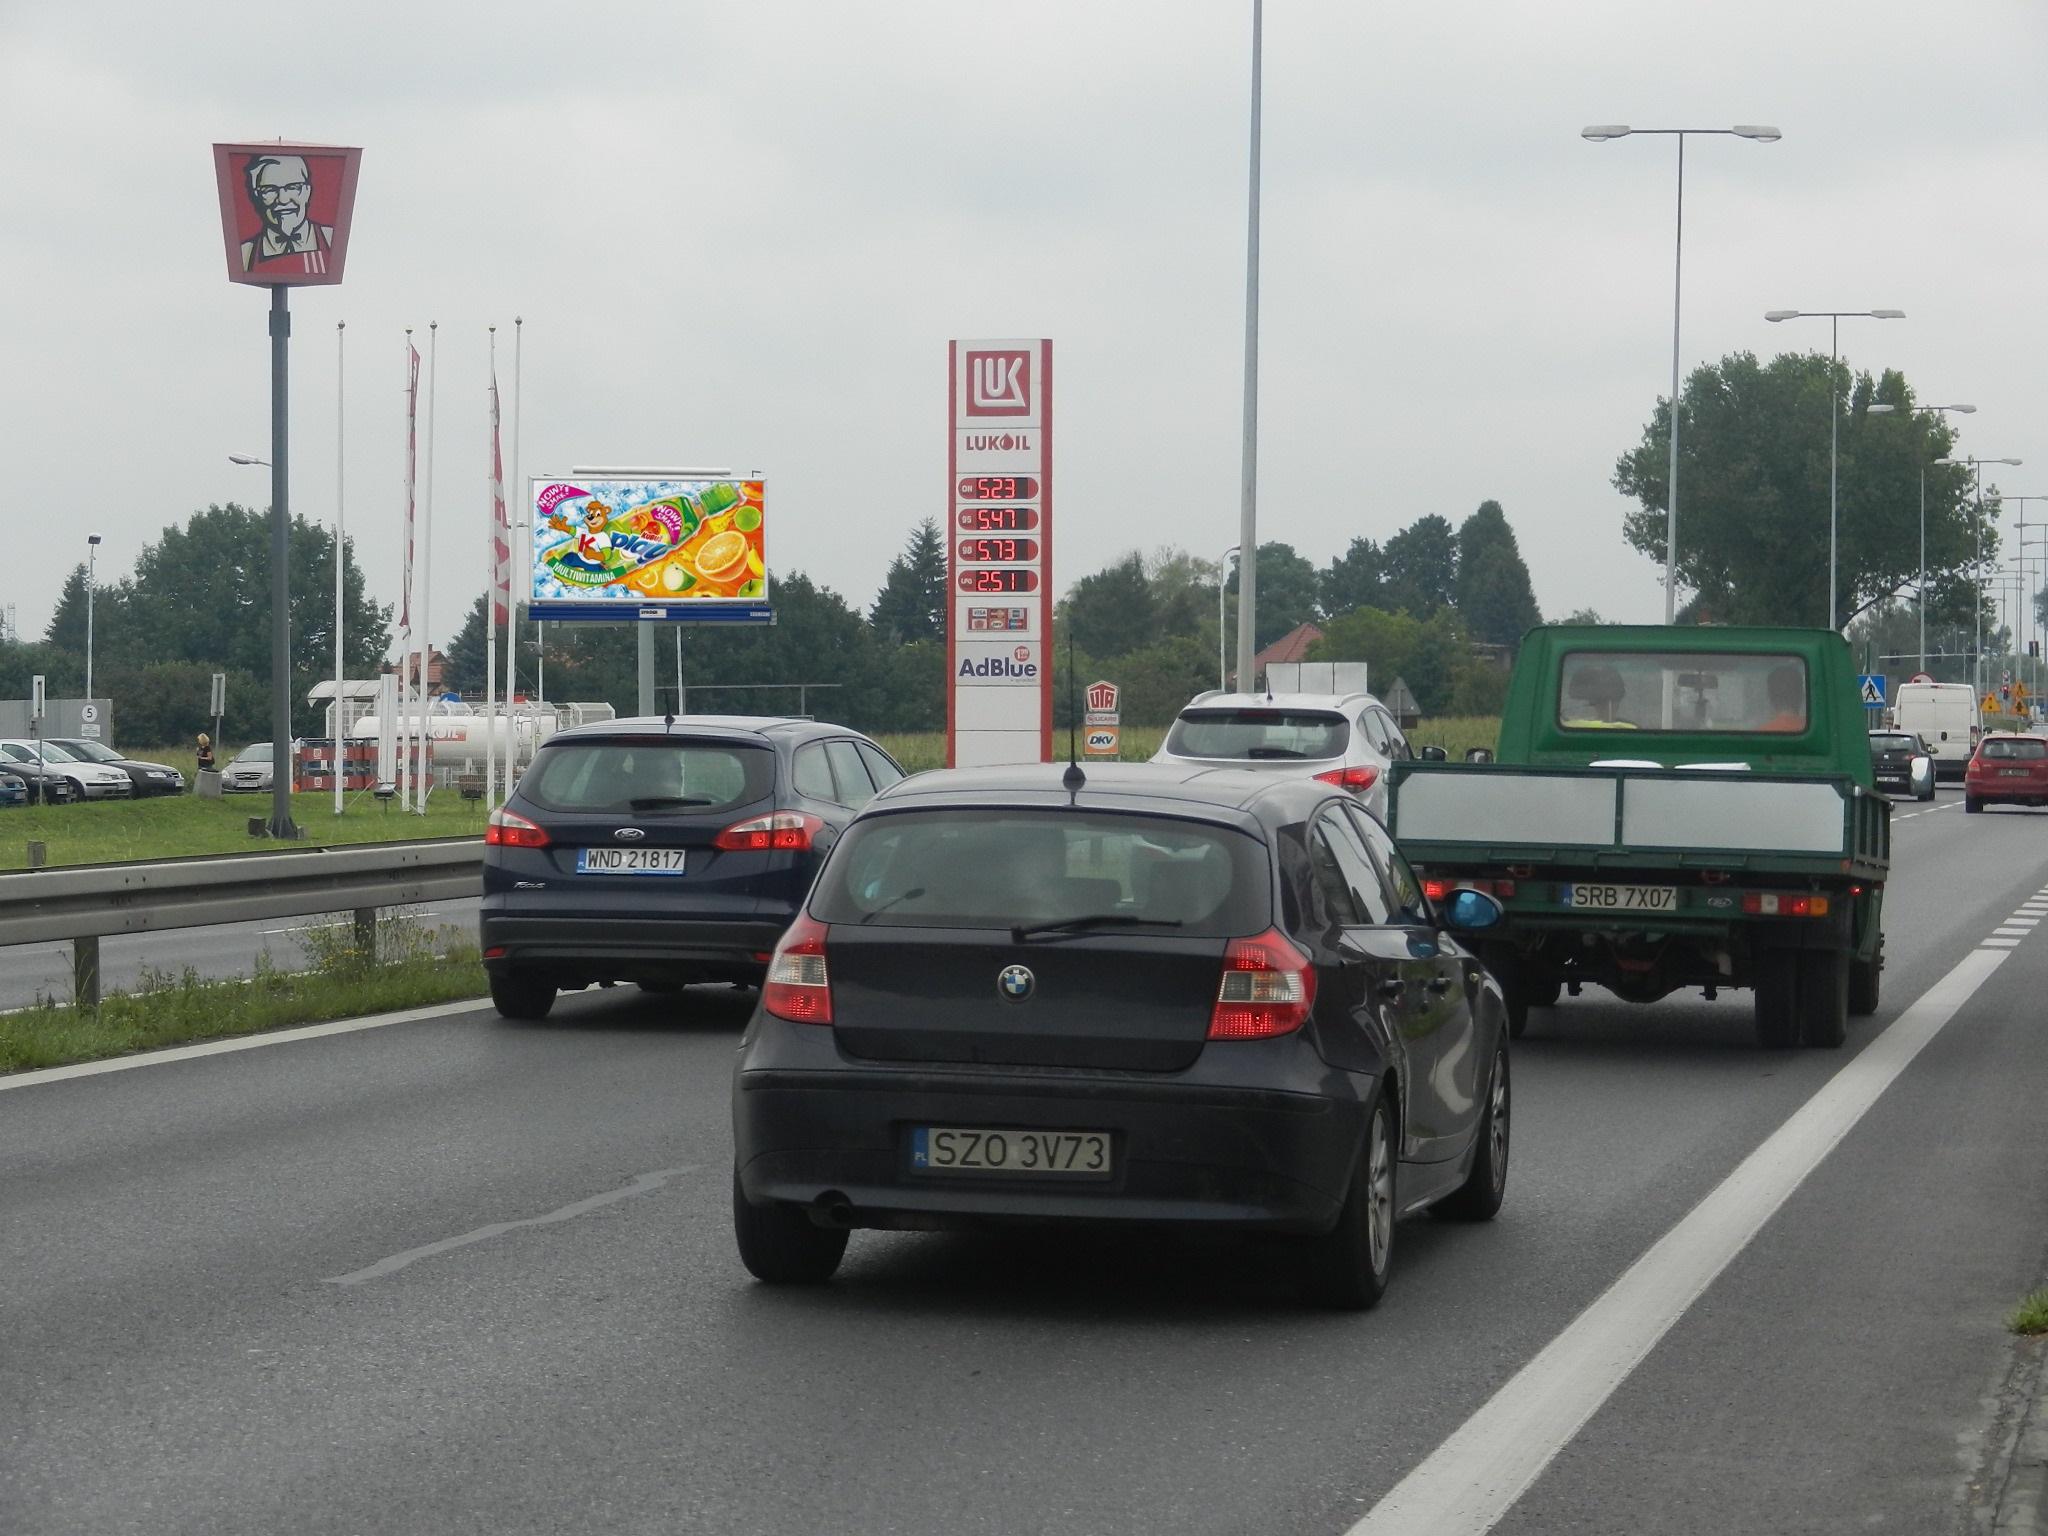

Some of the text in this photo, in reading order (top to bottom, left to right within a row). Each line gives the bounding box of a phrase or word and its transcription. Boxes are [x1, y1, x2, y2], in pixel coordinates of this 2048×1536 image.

[966, 433, 1031, 451] LUKOIL
[978, 509, 1015, 530] 5.47
[978, 540, 1015, 561] 5.73
[552, 562, 616, 584] MULTIWITAMINA
[958, 657, 1037, 677] AdBlue
[1089, 683, 1116, 709] UTA
[86, 707, 93, 718] 5
[1089, 735, 1114, 745] DKV
[588, 850, 623, 869] WND
[628, 850, 684, 869] 21817
[1575, 886, 1618, 907] SRB
[1625, 887, 1673, 908] 7X07
[934, 1131, 1007, 1167] SZO
[1021, 1133, 1105, 1170] 3V73
